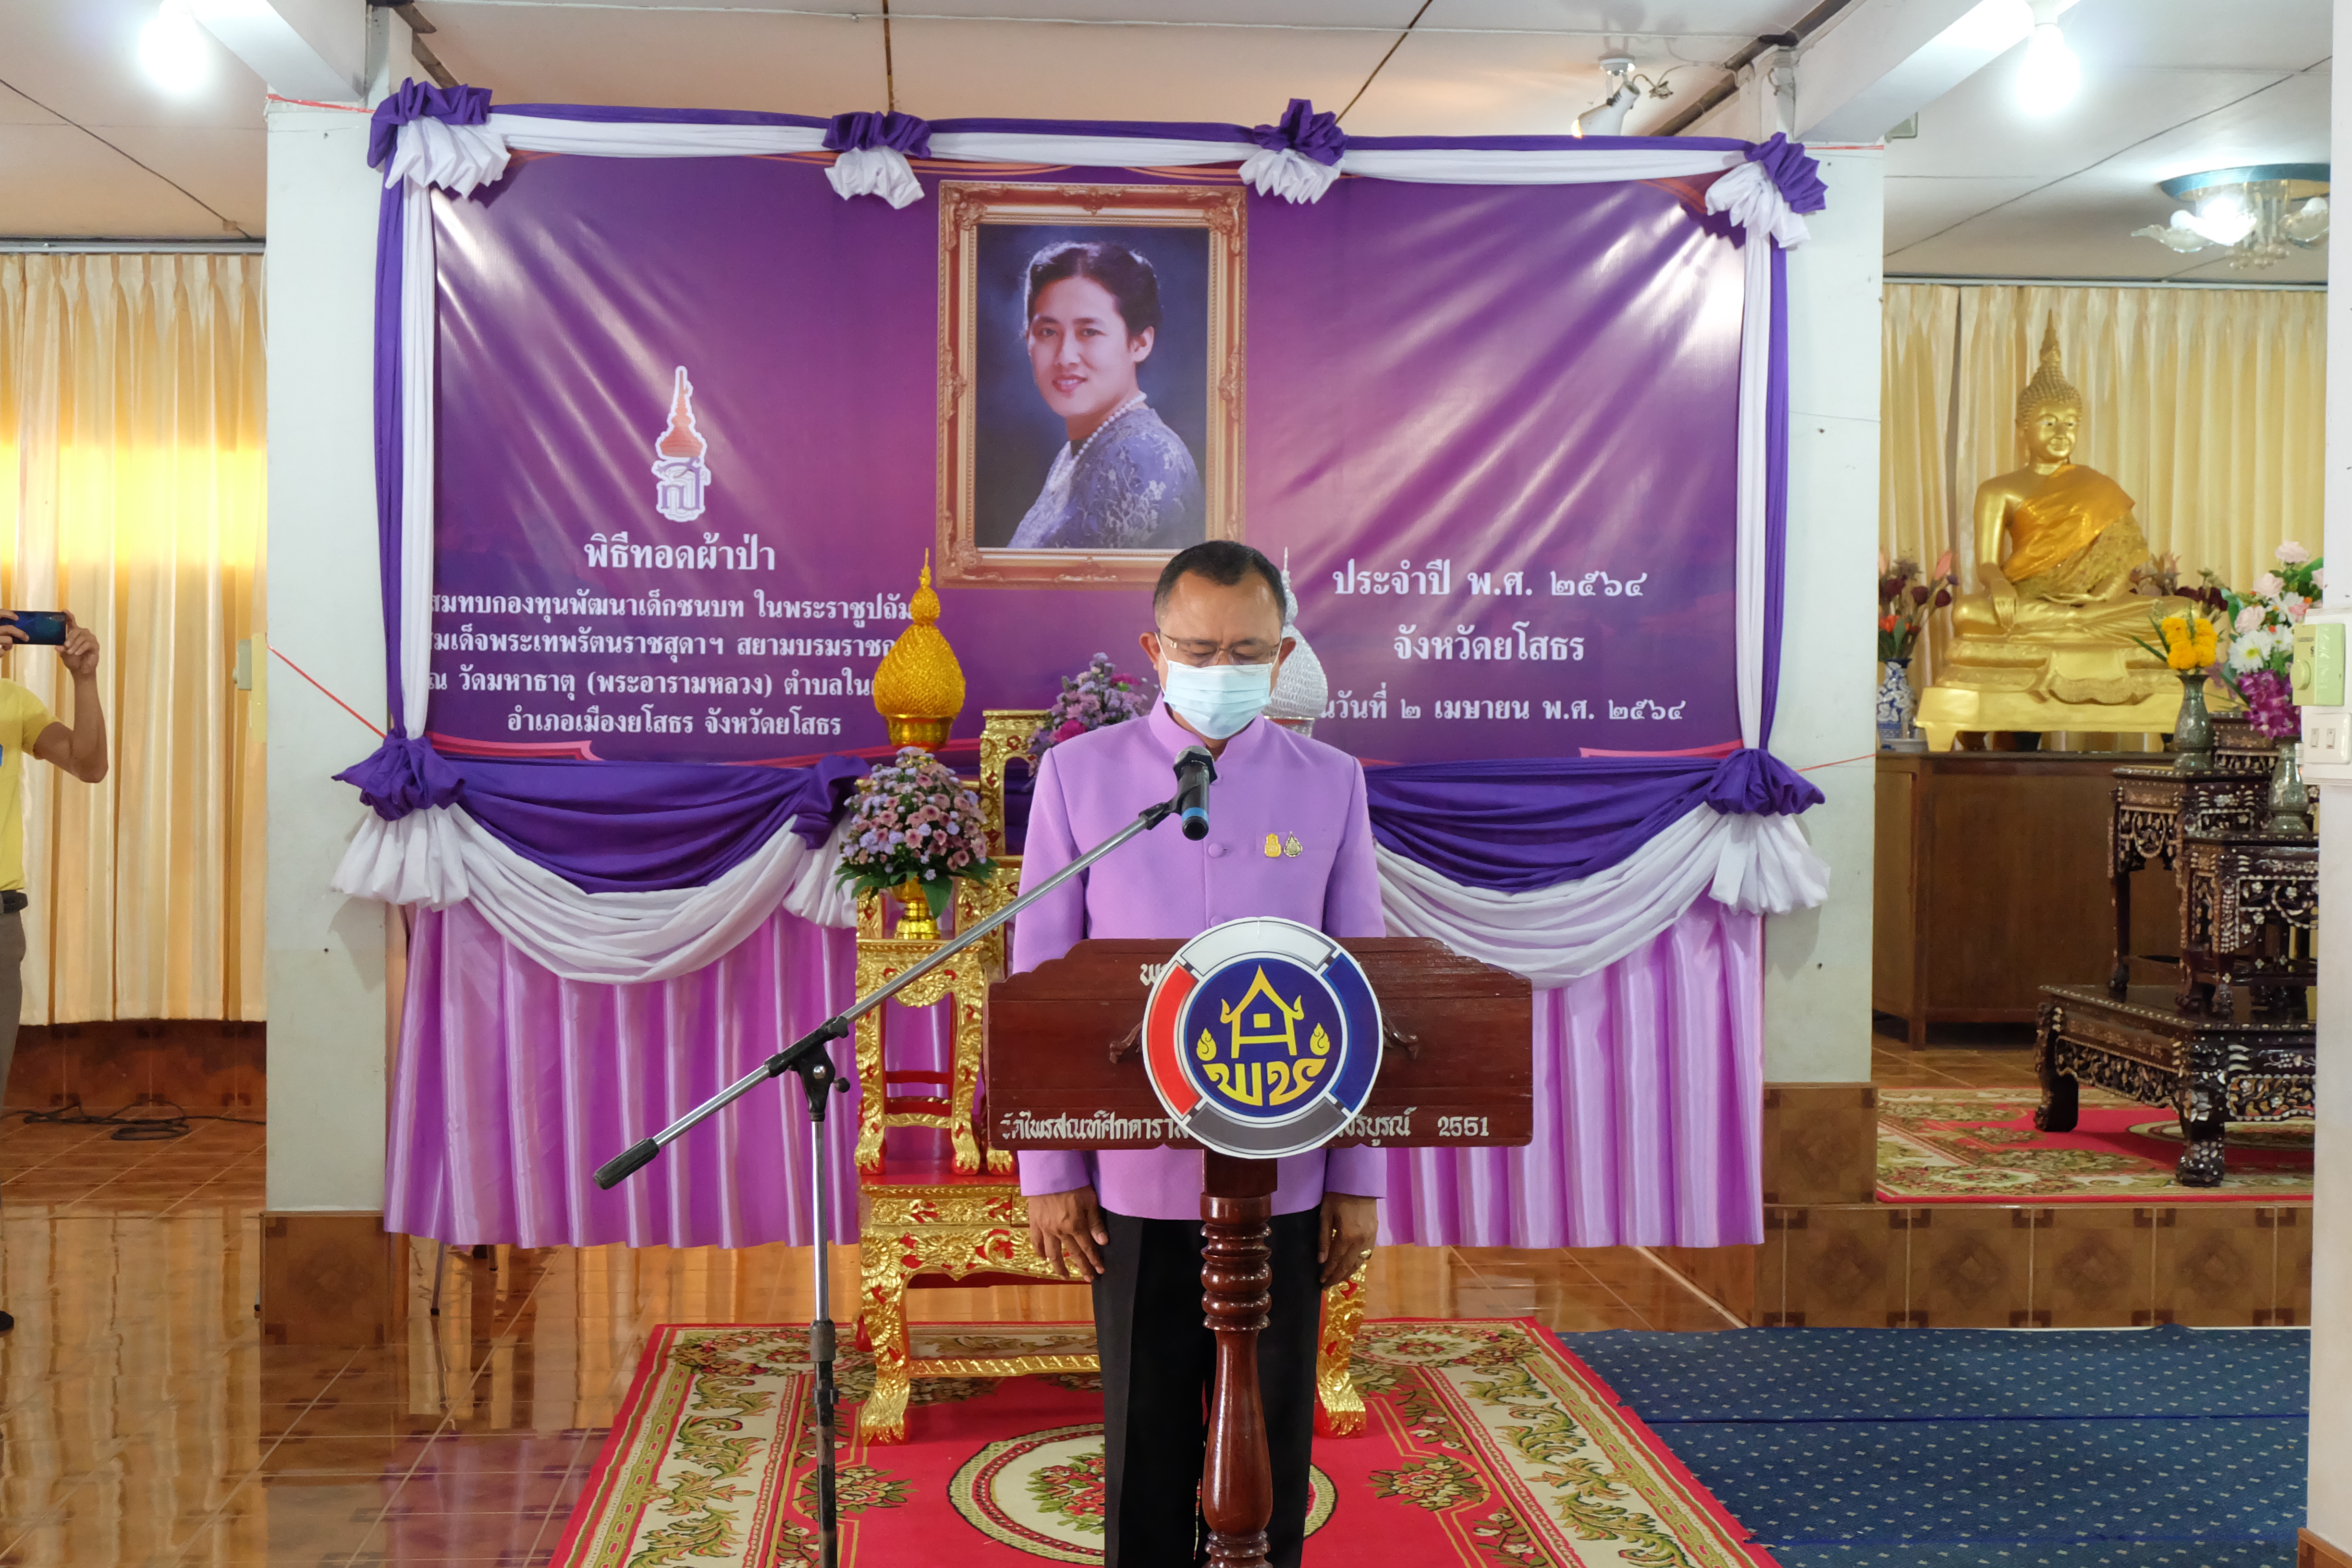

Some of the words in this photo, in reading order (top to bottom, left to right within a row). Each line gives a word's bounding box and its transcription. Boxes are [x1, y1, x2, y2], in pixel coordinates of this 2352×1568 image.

[584, 531, 775, 570] พิธีทอดผ้าป่า
[1332, 558, 1450, 595] ประจำปี
[1468, 570, 1533, 596] พ.ศ.
[1551, 570, 1647, 596] ๒๕๖๔
[754, 589, 913, 628] ในพระราชูปถัม
[432, 623, 723, 663] มเด็จพระเทพรัตนราชสุดาฯ
[1394, 621, 1585, 661] จังหวัดยโสธร
[459, 664, 575, 700] วัดมหาธาตุ
[587, 671, 772, 698] (พระอารามหลวง)
[784, 667, 875, 696] ตำบลใน
[1320, 682, 1386, 719] นวันที่
[1400, 698, 1421, 719] ๒
[1434, 700, 1530, 719] เมษายน
[1542, 699, 1595, 720] พ.ศ.
[1608, 699, 1686, 720] ๒๕๖๔
[507, 704, 693, 733] อำเภอเมืองยโสธร
[705, 705, 842, 735] จังหวัดยโสธร
